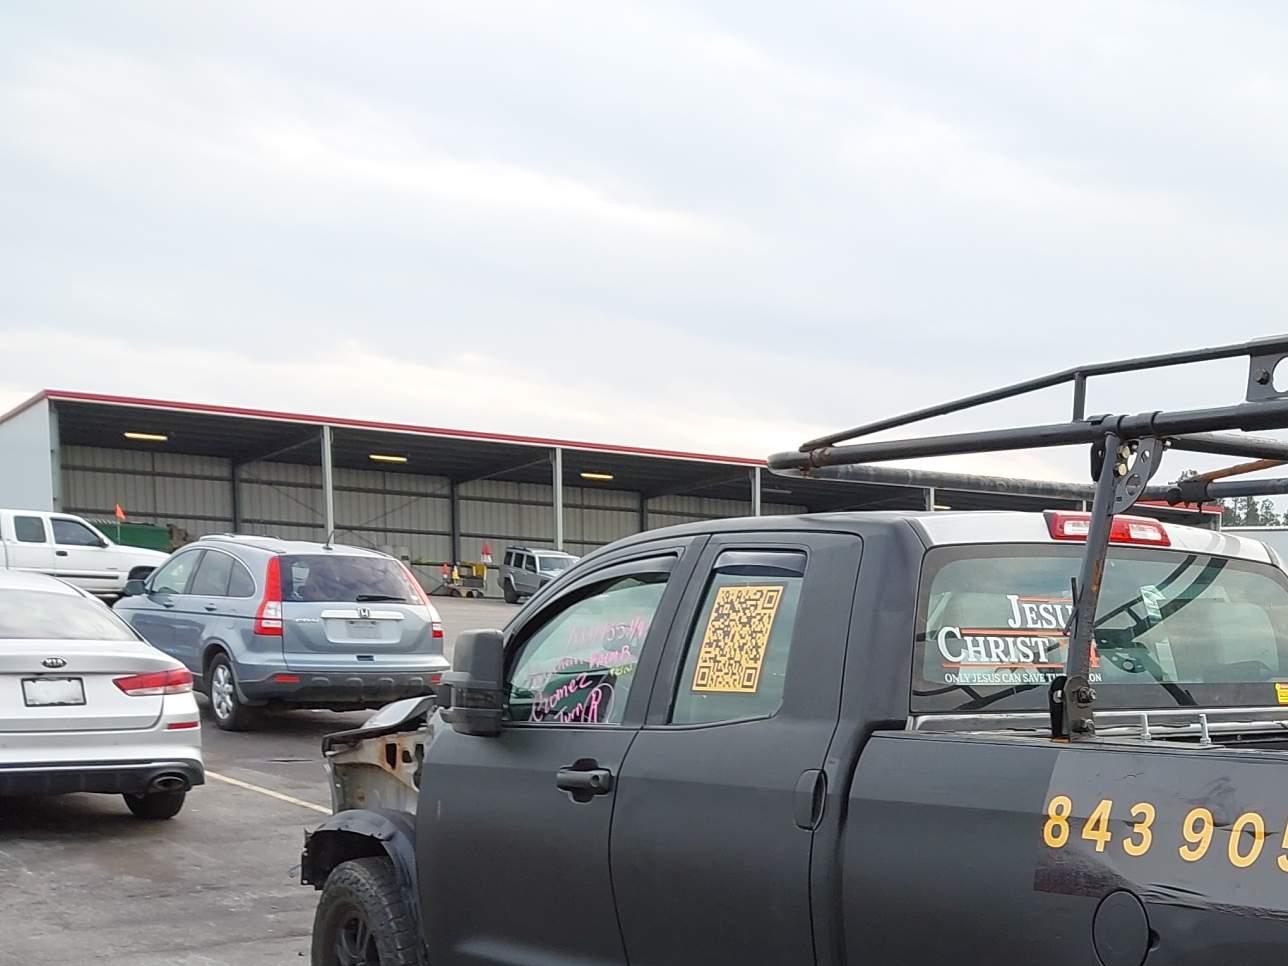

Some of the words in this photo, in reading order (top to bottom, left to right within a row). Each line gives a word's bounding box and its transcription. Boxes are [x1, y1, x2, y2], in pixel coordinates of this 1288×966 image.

[1006, 594, 1072, 628] JESU
[937, 627, 1049, 662] CHRIST
[945, 673, 970, 683] ONLY
[971, 673, 1000, 683] JESUS
[1002, 673, 1022, 683] CAN
[1023, 673, 1045, 683] SAVE
[1043, 796, 1156, 856] 843
